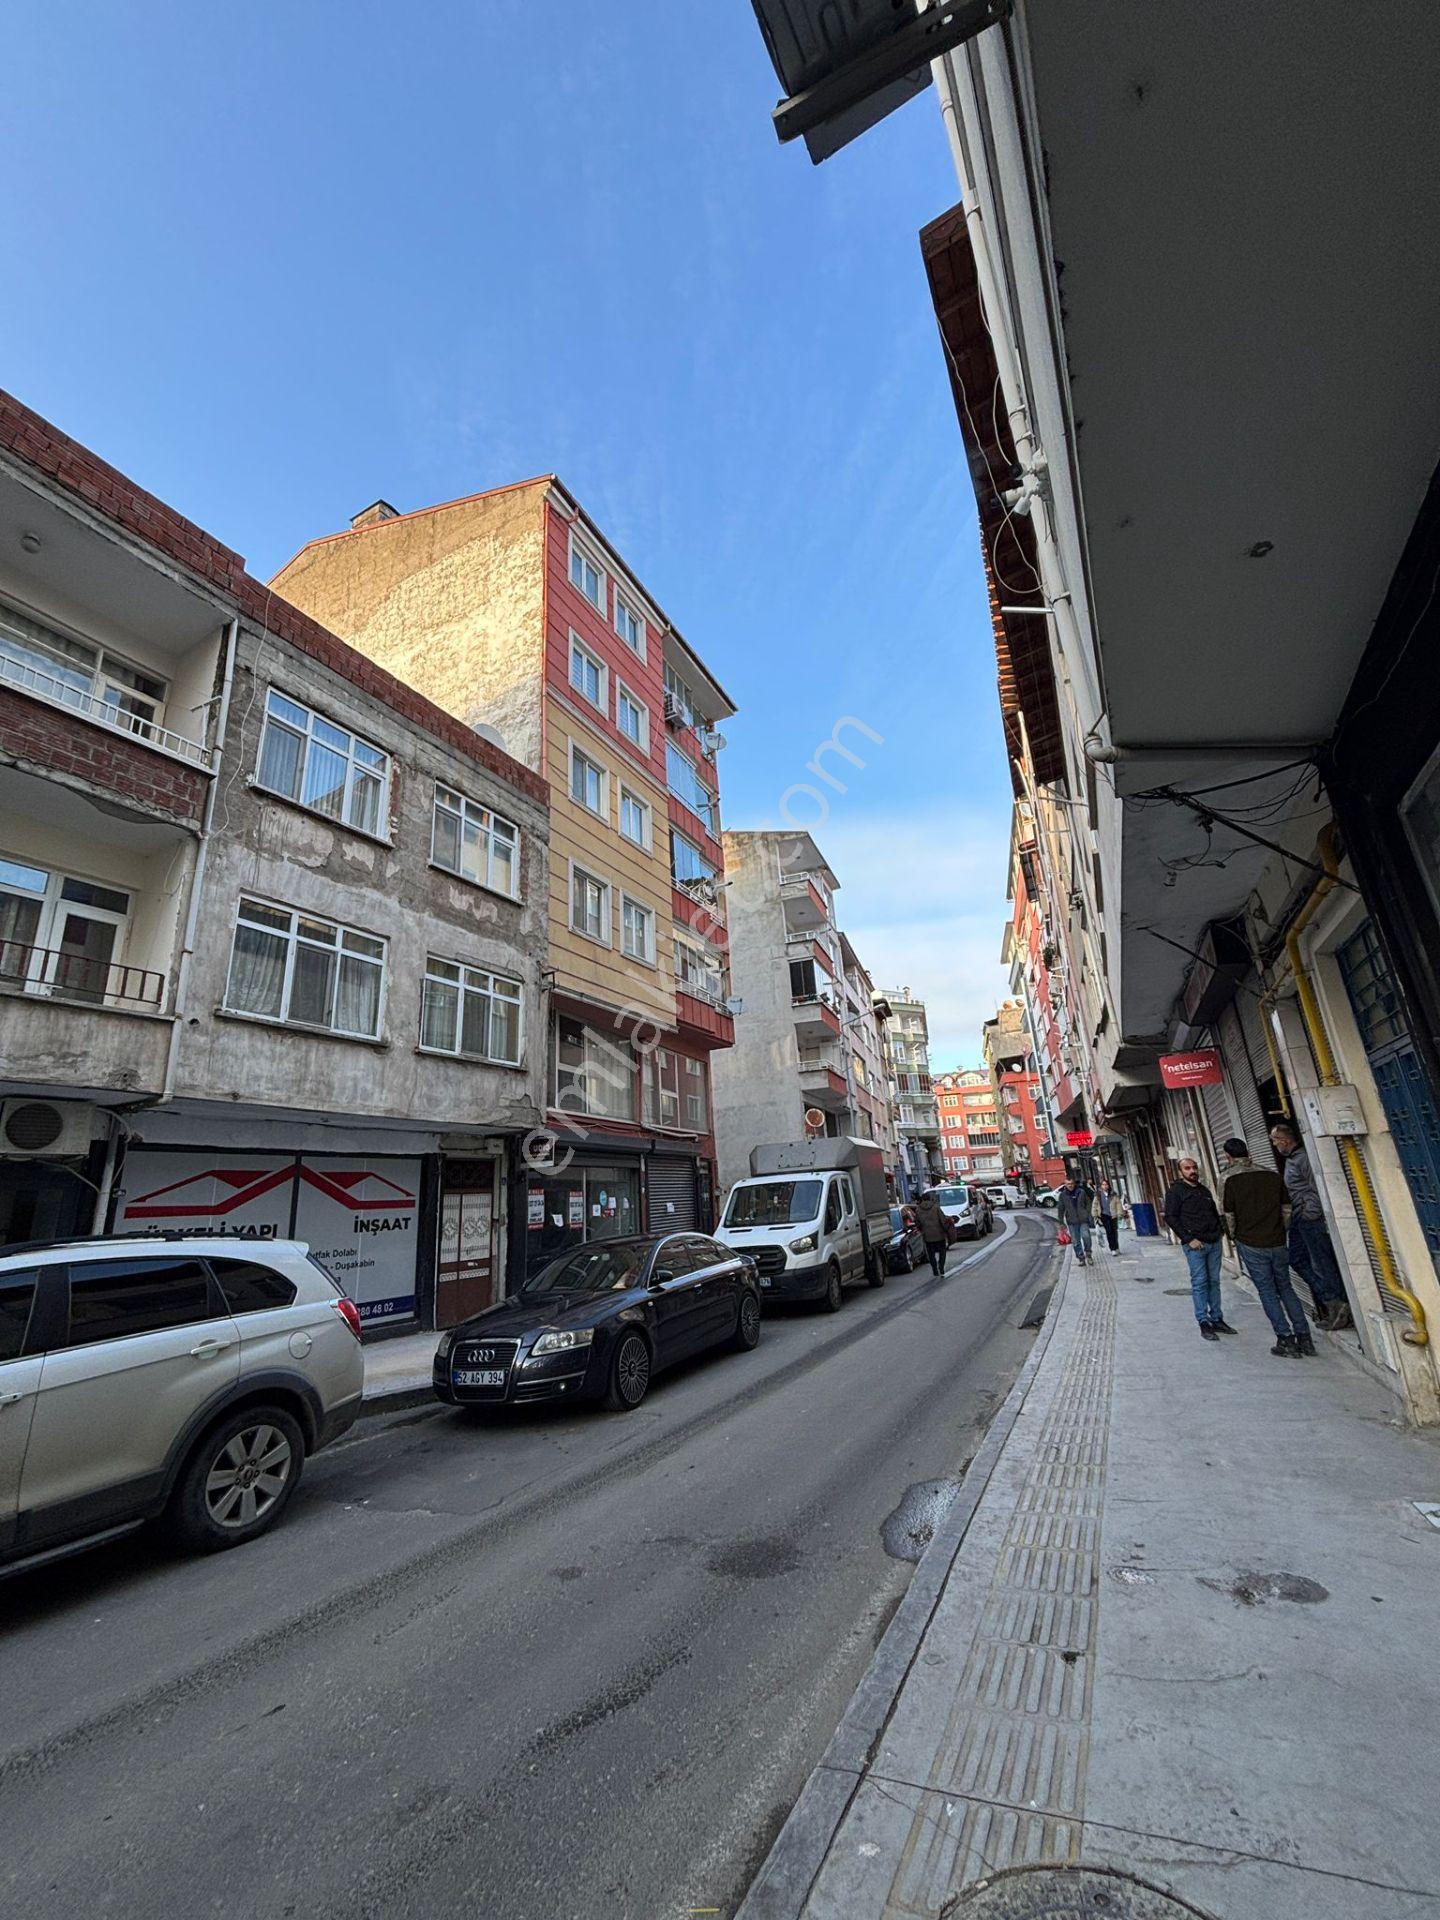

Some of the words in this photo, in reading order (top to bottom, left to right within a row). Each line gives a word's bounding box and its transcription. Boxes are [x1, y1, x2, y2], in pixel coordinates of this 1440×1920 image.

[1167, 1060, 1213, 1073] netelsan
[353, 1215, 411, 1236] İNŞAAT
[335, 1258, 375, 1271] Duşakabin
[372, 1304, 382, 1314] 48
[384, 1302, 394, 1312] 02
[471, 1372, 485, 1384] AGY
[488, 1372, 503, 1383] 394
